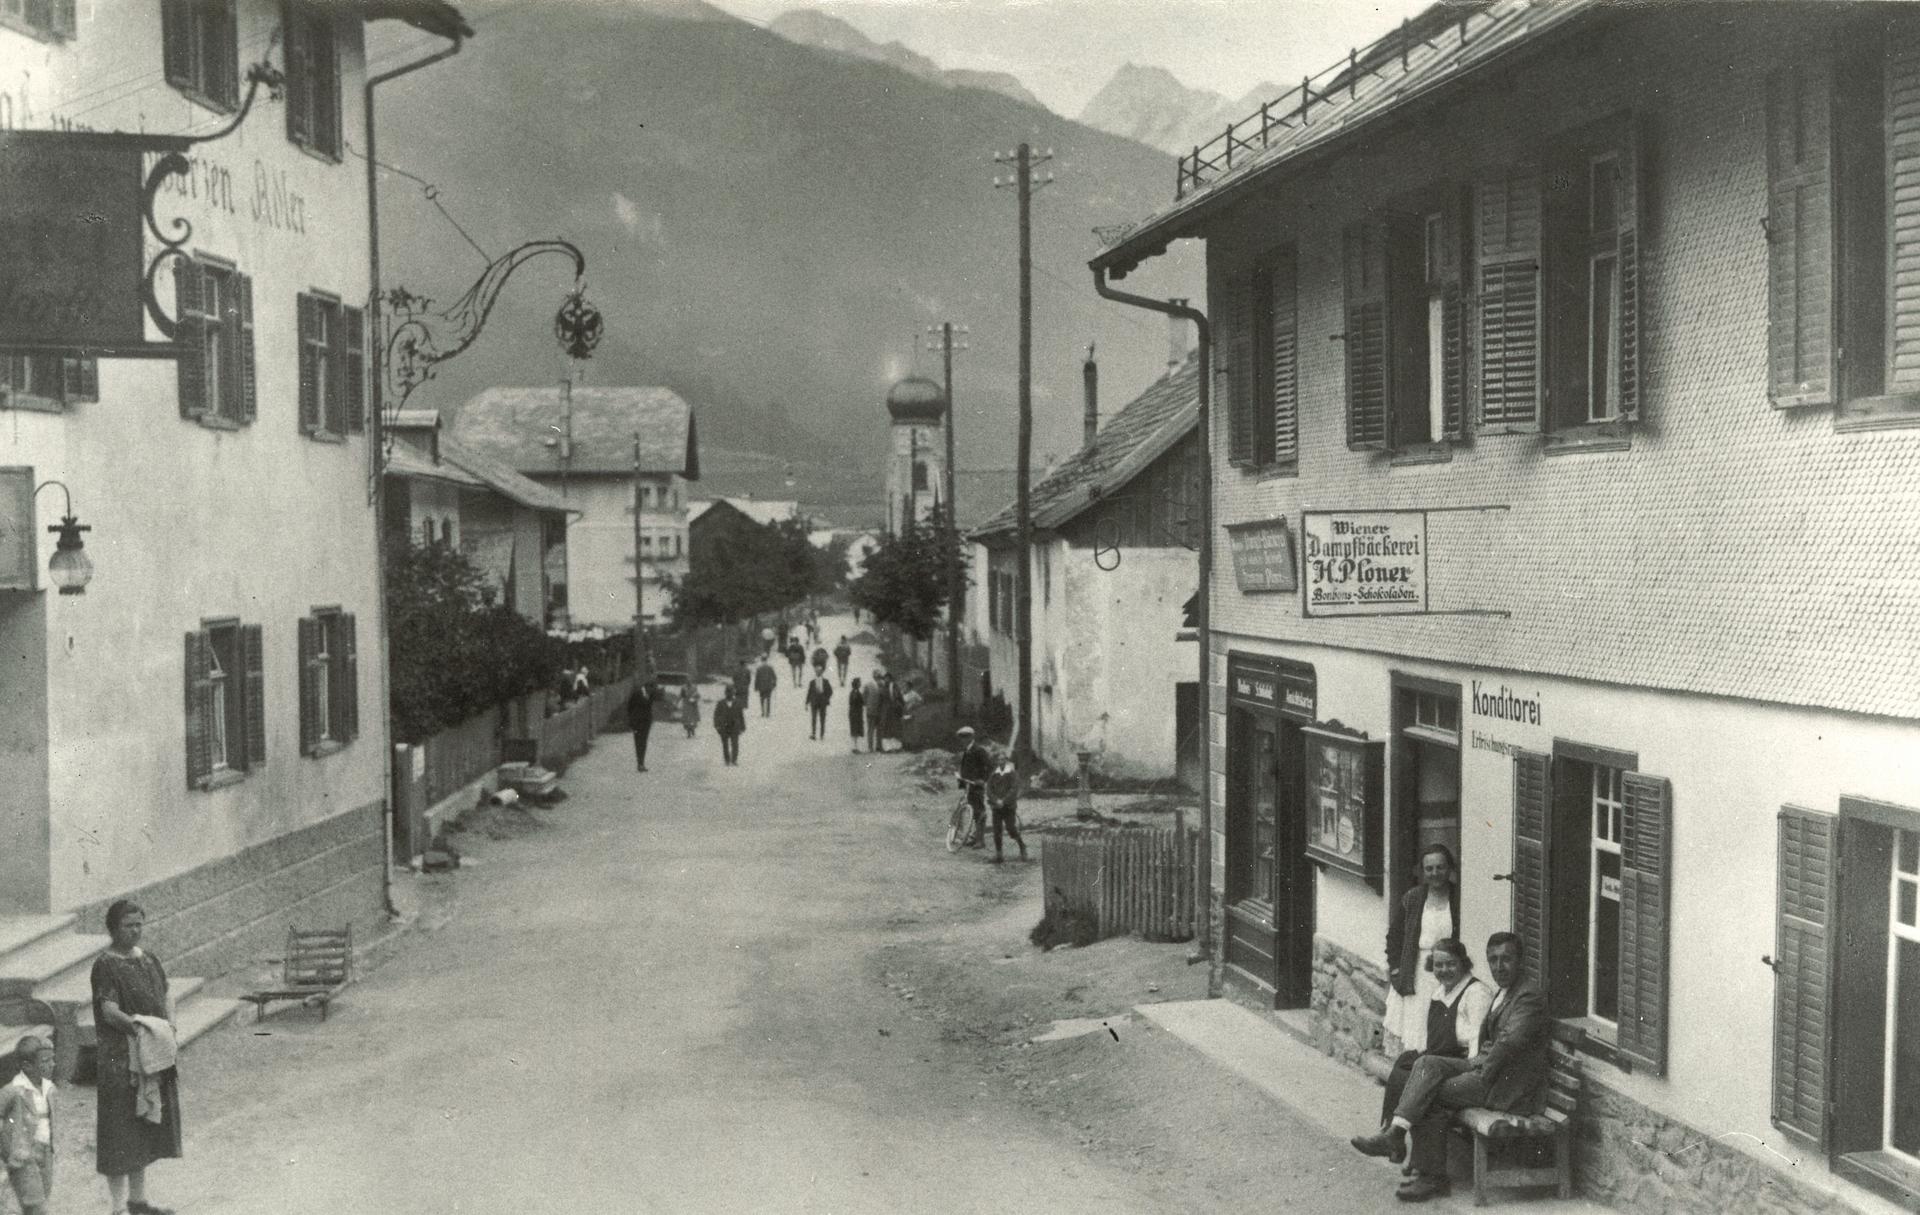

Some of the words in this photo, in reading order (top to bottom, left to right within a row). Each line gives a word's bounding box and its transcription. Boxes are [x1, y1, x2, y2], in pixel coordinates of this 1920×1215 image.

[1332, 521, 1390, 537] Wiener
[1307, 533, 1420, 560] Dampfbäckerei
[1471, 679, 1541, 726] Konditorei
